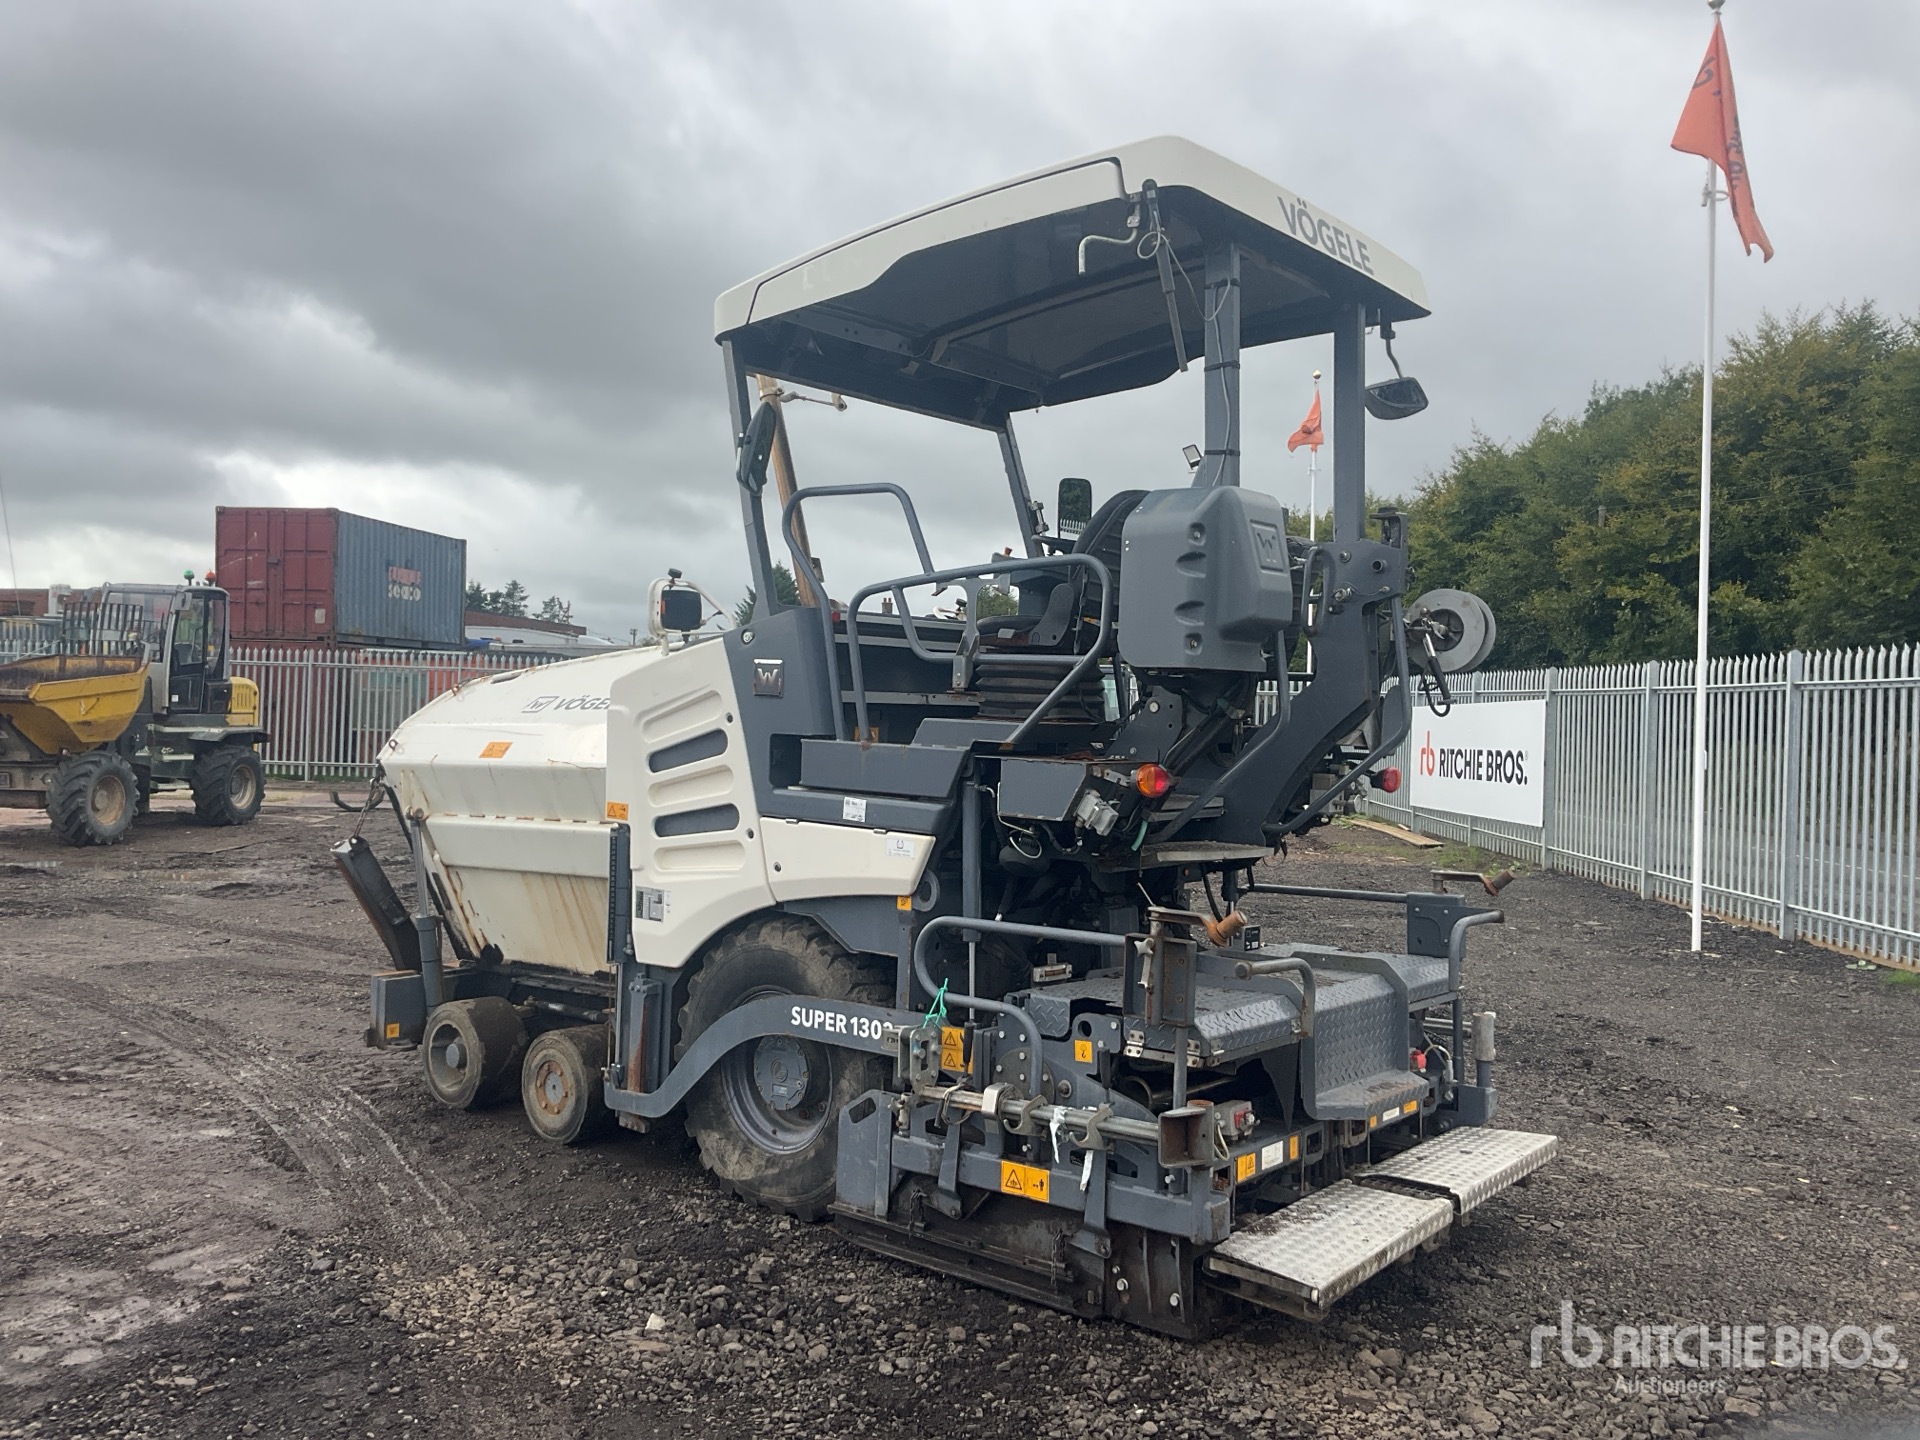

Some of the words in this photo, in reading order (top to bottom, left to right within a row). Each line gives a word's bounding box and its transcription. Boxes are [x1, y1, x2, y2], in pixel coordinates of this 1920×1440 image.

[1277, 195, 1375, 276] VÖGELE
[1439, 748, 1483, 781] RITCHIE
[1486, 749, 1528, 786] BROS.
[791, 1006, 847, 1034] SUPER
